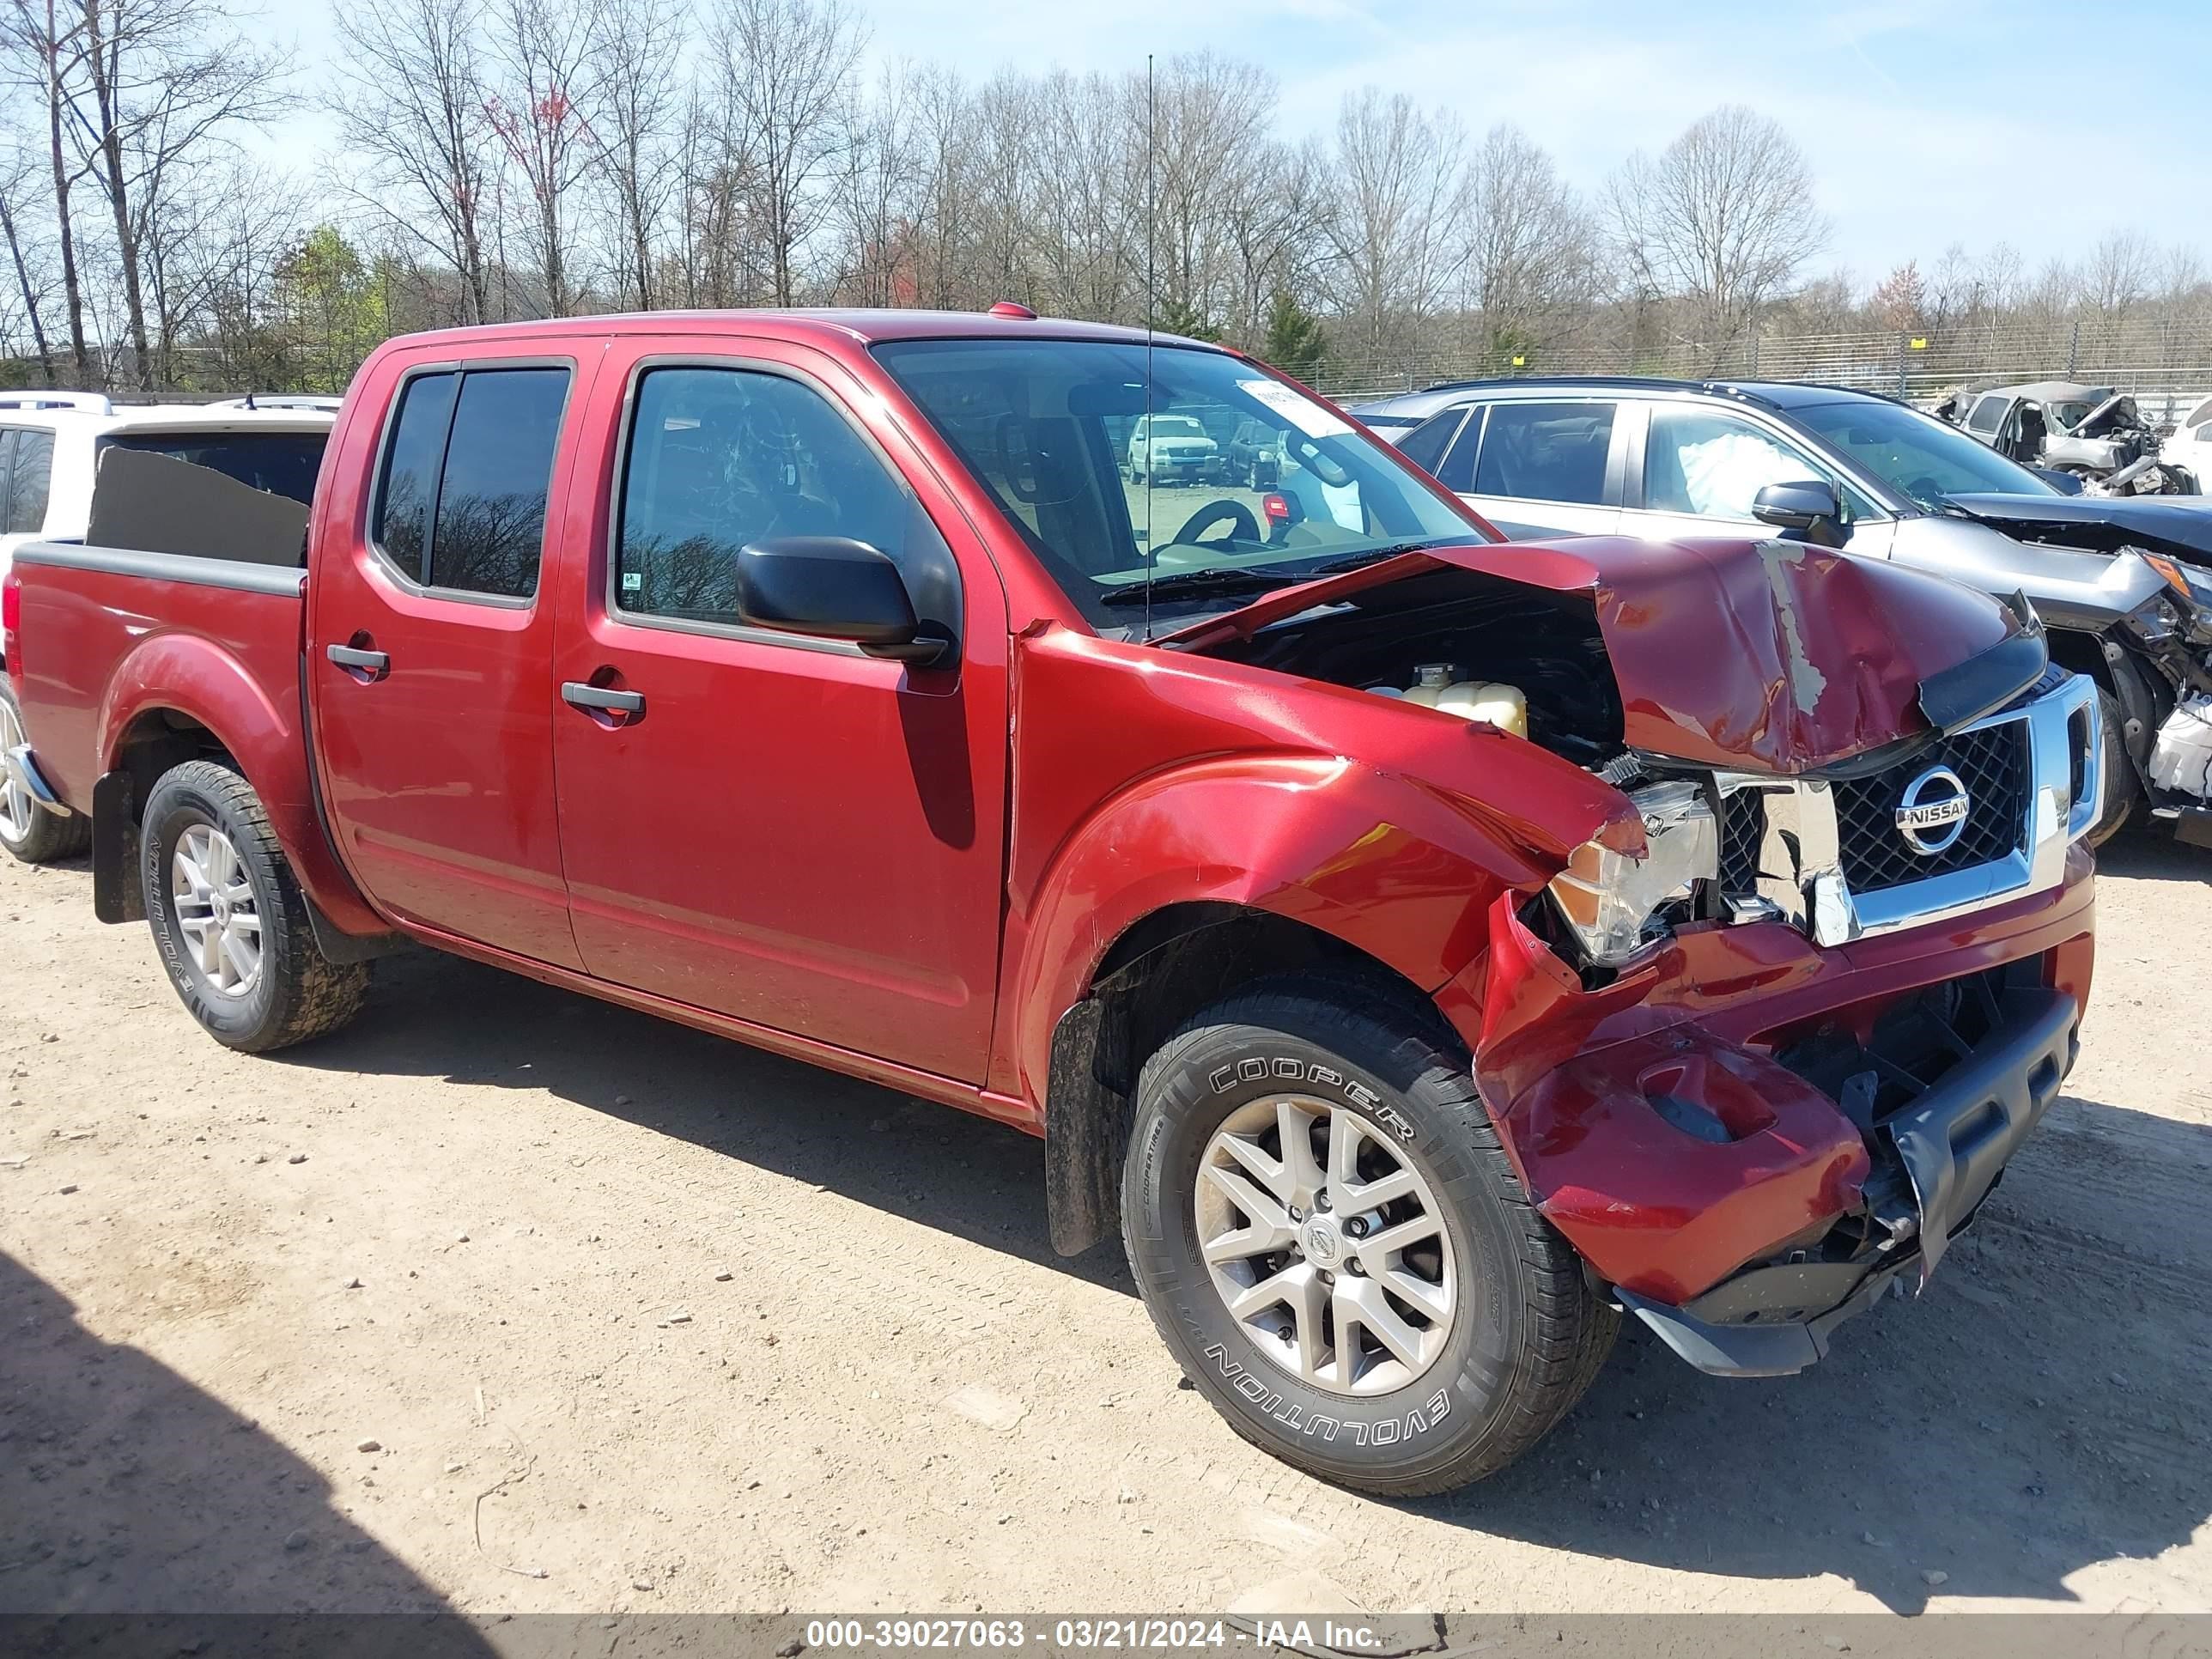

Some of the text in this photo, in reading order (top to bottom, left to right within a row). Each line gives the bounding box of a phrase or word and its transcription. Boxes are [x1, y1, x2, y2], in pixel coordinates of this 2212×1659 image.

[1910, 799, 1968, 824] NISSAN
[149, 836, 196, 993] EVOLUTION
[1208, 1056, 1417, 1144] COOPER
[1203, 1341, 1452, 1448] EVOLUTION
